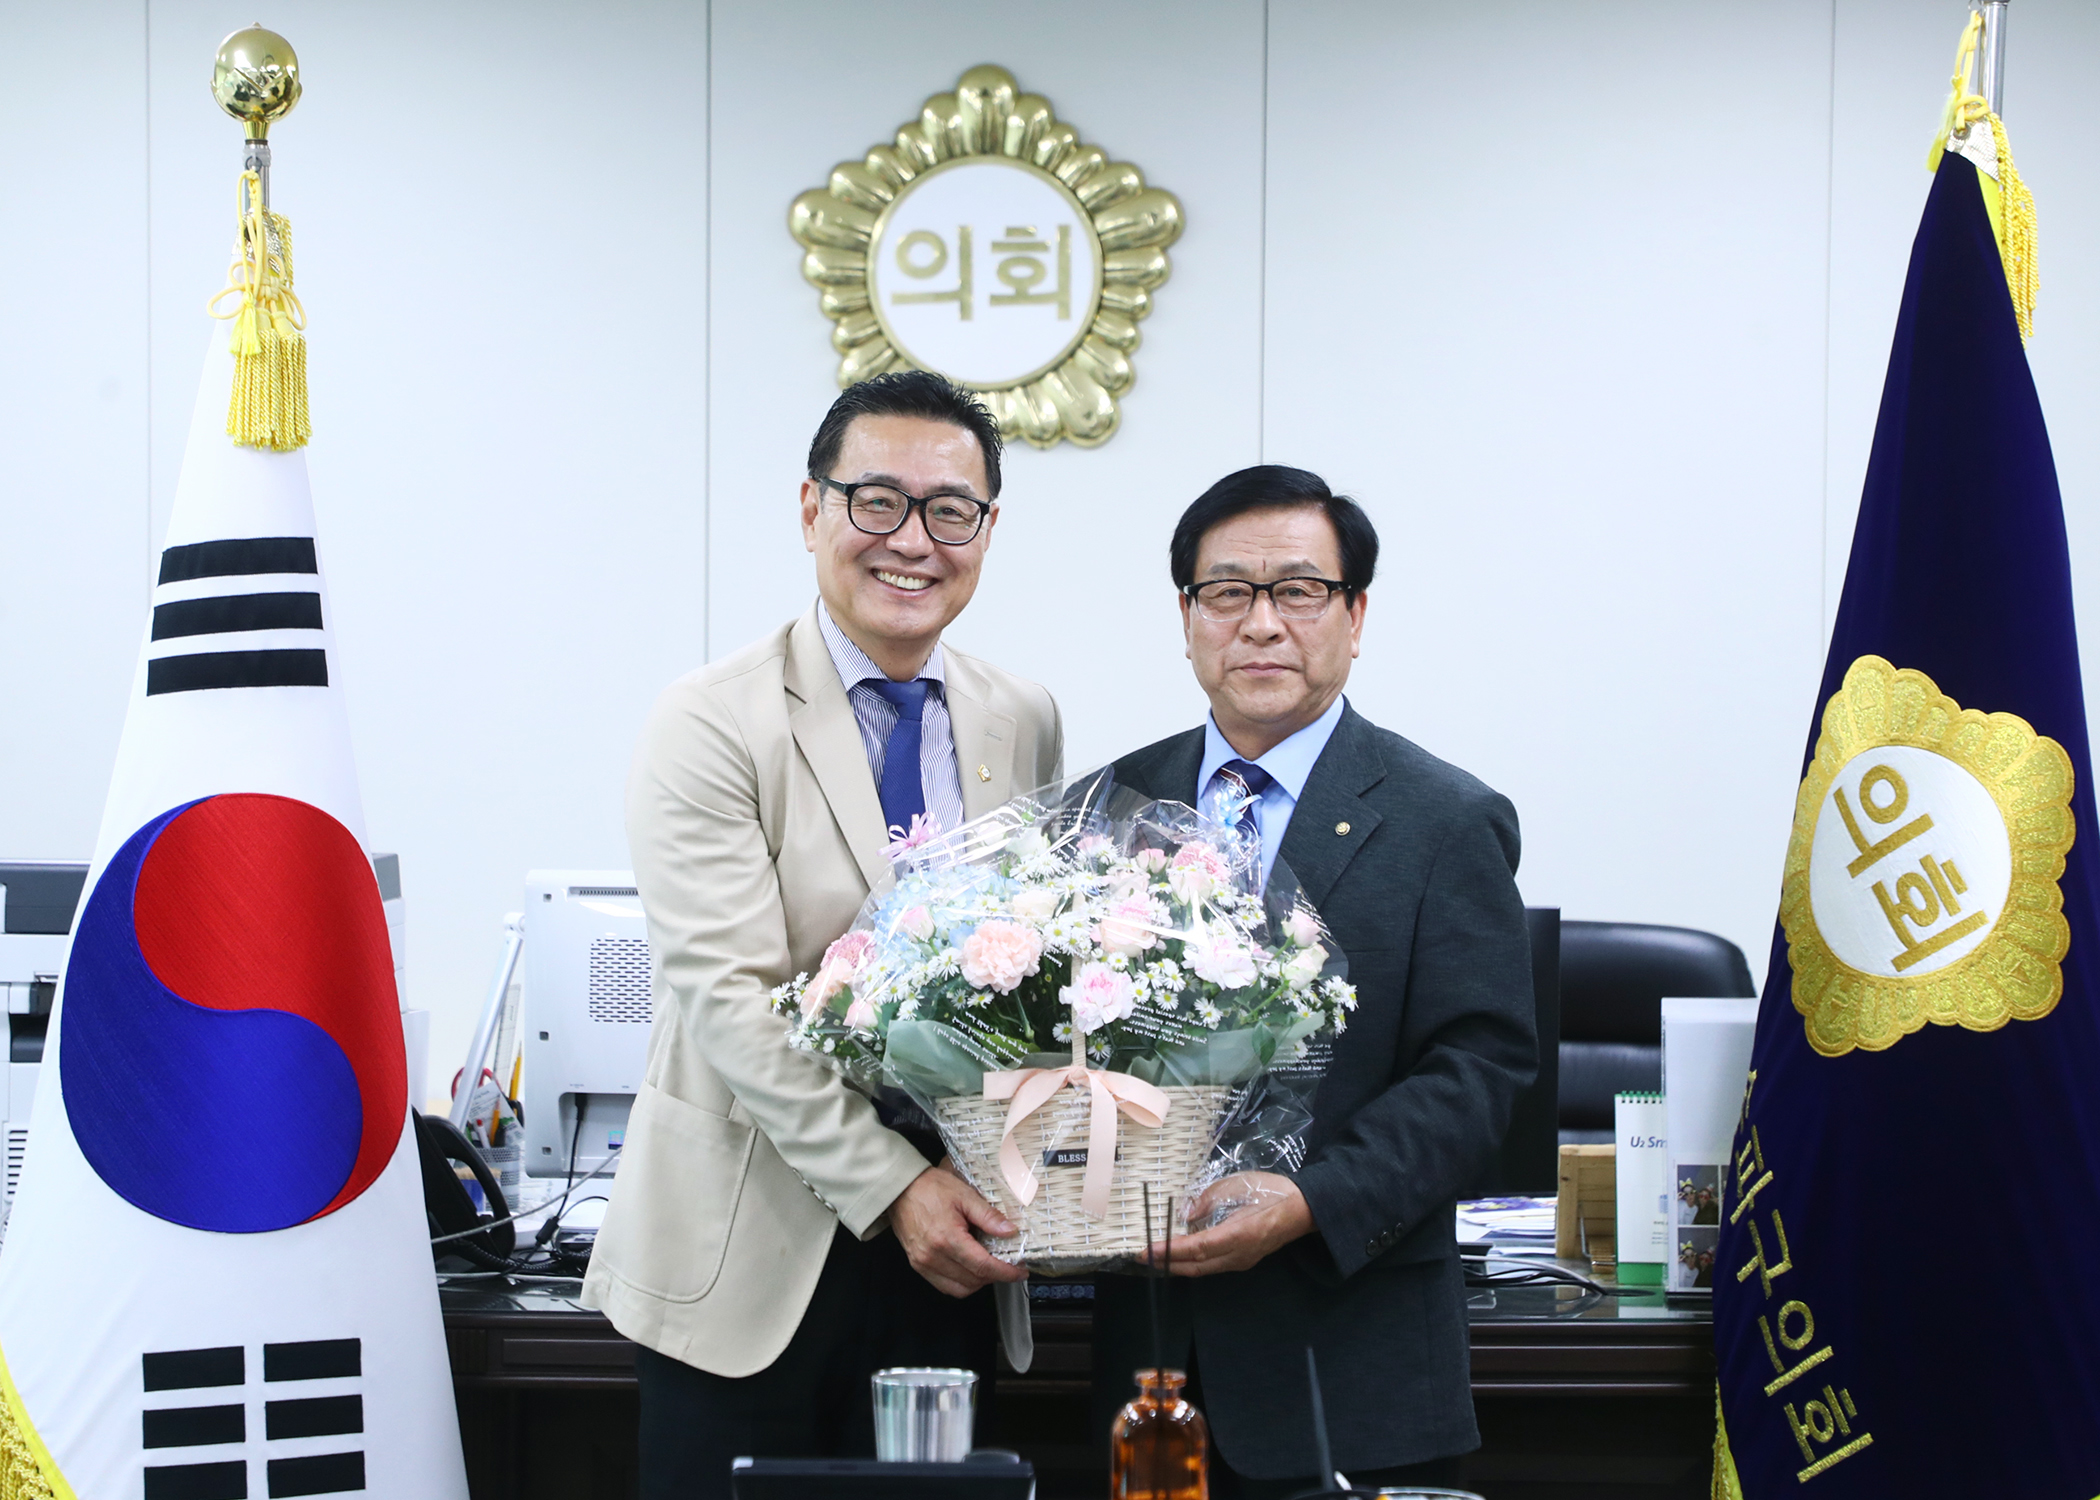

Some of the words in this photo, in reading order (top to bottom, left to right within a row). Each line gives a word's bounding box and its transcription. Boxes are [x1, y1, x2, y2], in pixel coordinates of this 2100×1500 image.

[891, 224, 1070, 321] 의회
[1833, 763, 1988, 972] 의회
[1058, 1154, 1088, 1163] BLESS
